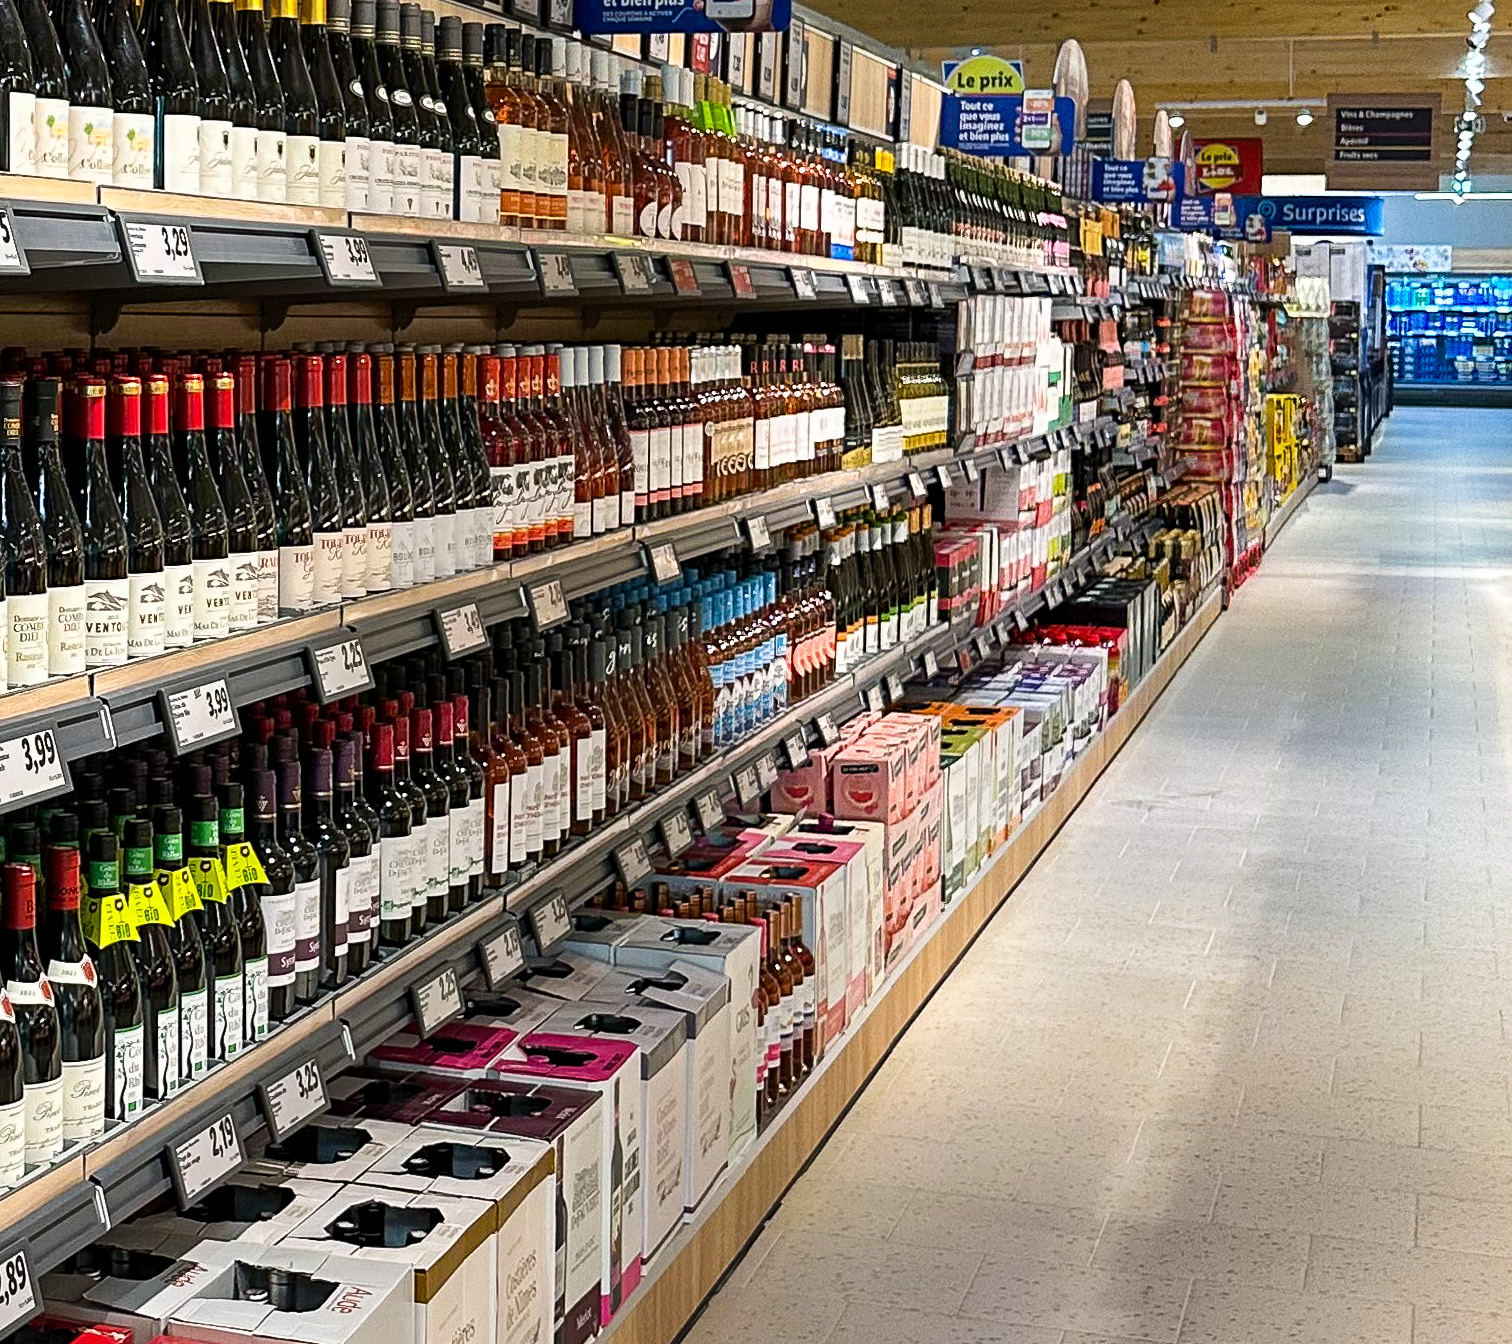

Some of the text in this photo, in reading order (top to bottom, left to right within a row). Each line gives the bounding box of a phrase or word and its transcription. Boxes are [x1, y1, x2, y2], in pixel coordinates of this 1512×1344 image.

[958, 71, 1013, 92] Le prix
[1283, 203, 1366, 225] Surprises
[162, 226, 188, 260] 3,29
[21, 732, 55, 774] 3,99
[296, 1061, 319, 1099] 3,25
[210, 1116, 233, 1157] 2,19
[327, 1286, 372, 1315] Aude
